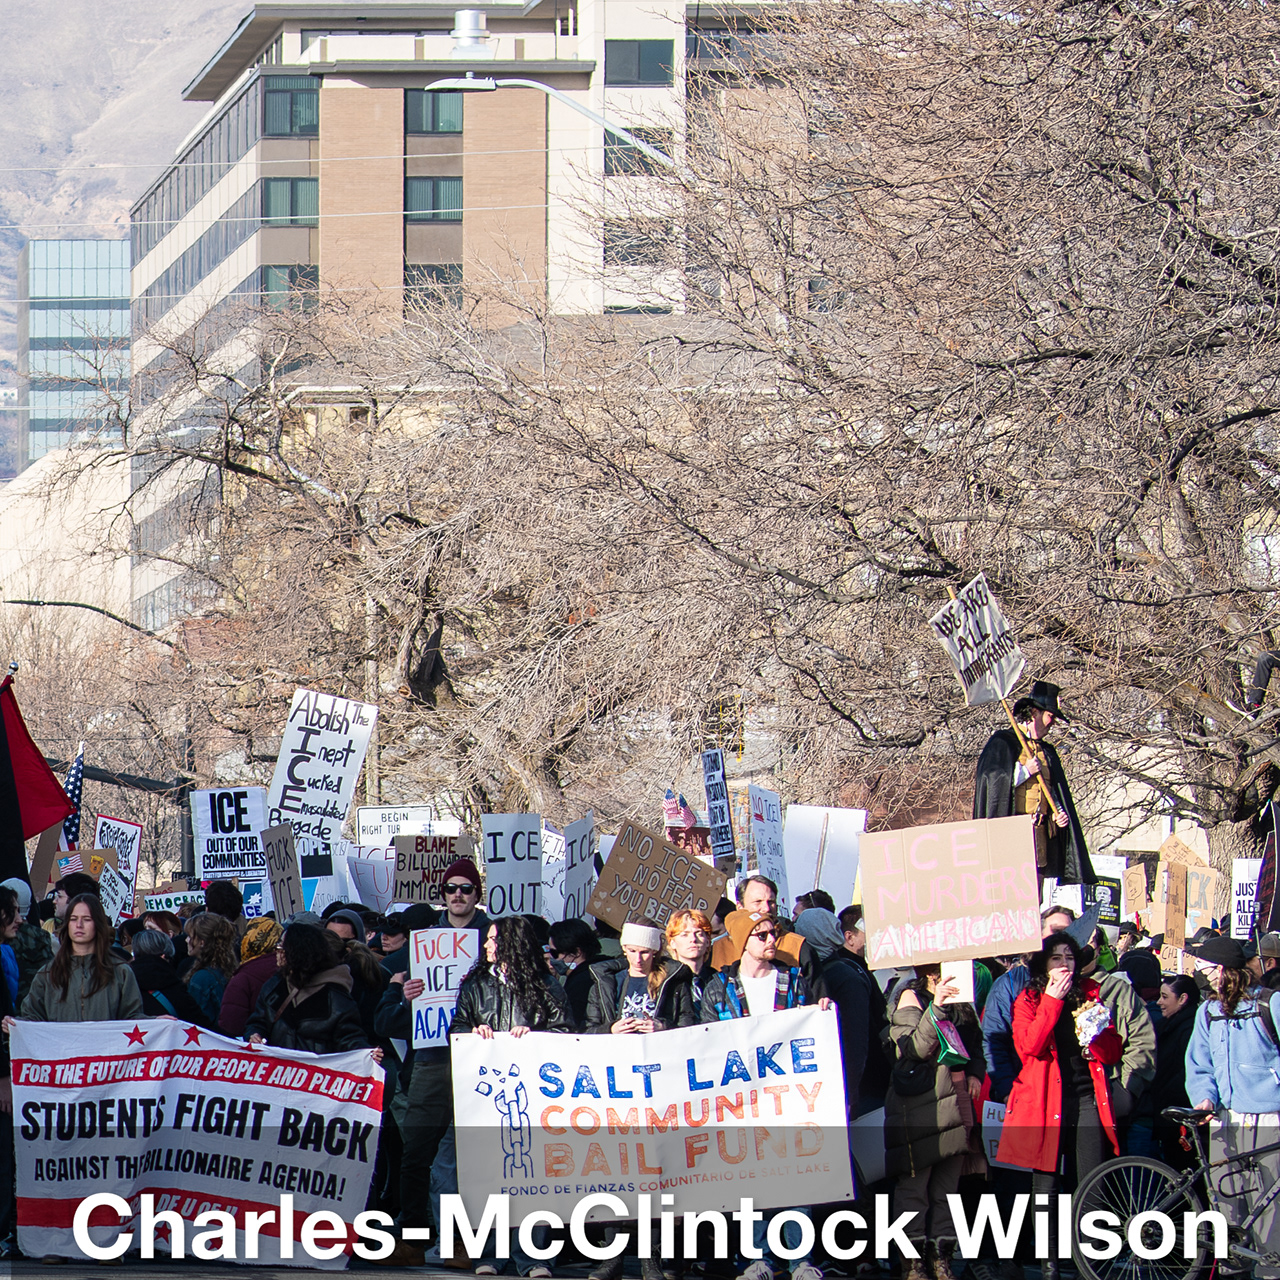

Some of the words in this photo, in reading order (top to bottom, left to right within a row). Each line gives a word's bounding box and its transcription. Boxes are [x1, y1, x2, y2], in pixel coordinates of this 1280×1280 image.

[935, 606, 961, 638] WE
[961, 581, 988, 621] ARE
[958, 621, 990, 652] ALL
[959, 630, 1014, 690] IMMIGRANTS
[290, 691, 351, 735] Abolish
[353, 703, 370, 726] The
[209, 791, 251, 834] ICE
[362, 825, 382, 835] RIGHT
[381, 813, 408, 822] BEGIN
[203, 852, 266, 869] COMMUNITIES
[207, 837, 224, 853] OUT
[226, 837, 237, 852] OF
[238, 836, 258, 851] OUR
[266, 838, 293, 876] FUCK
[415, 836, 458, 854] BLAME
[487, 830, 539, 863] ICE
[567, 828, 594, 870] ICE
[620, 826, 653, 860] NO
[654, 845, 701, 890] ICE
[874, 828, 978, 875] ICE
[422, 869, 444, 884] NOT
[610, 876, 644, 911] YOU
[633, 864, 660, 892] NO
[877, 862, 1038, 920] MURDERS
[489, 882, 541, 915] OUT
[413, 930, 470, 963] FUCK
[873, 906, 1040, 962] AMERICANS
[426, 964, 459, 992] ICE
[19, 1062, 52, 1084] FOR
[54, 1062, 84, 1085] THE
[87, 1056, 149, 1083] FUTURE
[149, 1055, 170, 1078] OF
[169, 1055, 204, 1076] OUR
[204, 1056, 264, 1084] PEOPLE
[267, 1065, 307, 1089] AND
[308, 1072, 374, 1102] PLANET
[539, 1062, 661, 1099] SALT
[687, 1037, 818, 1092] LAKE
[21, 1095, 166, 1142] STUDENTS
[173, 1093, 271, 1141] FIGHT
[277, 1106, 374, 1163] BACK
[539, 1081, 823, 1136] COMMUNITY
[543, 1141, 663, 1179] BAIL
[684, 1121, 825, 1170] FUND
[34, 1155, 109, 1183] AGAINST
[142, 1148, 254, 1184] BILLIONAIRE
[258, 1160, 347, 1202] AGENDA!
[501, 1185, 550, 1197] FONDO
[554, 1184, 572, 1195] DE
[639, 1170, 734, 1192] COMUNITARIO
[739, 1168, 756, 1179] DE
[761, 1165, 792, 1177] SALT
[796, 1162, 831, 1174] LAKE
